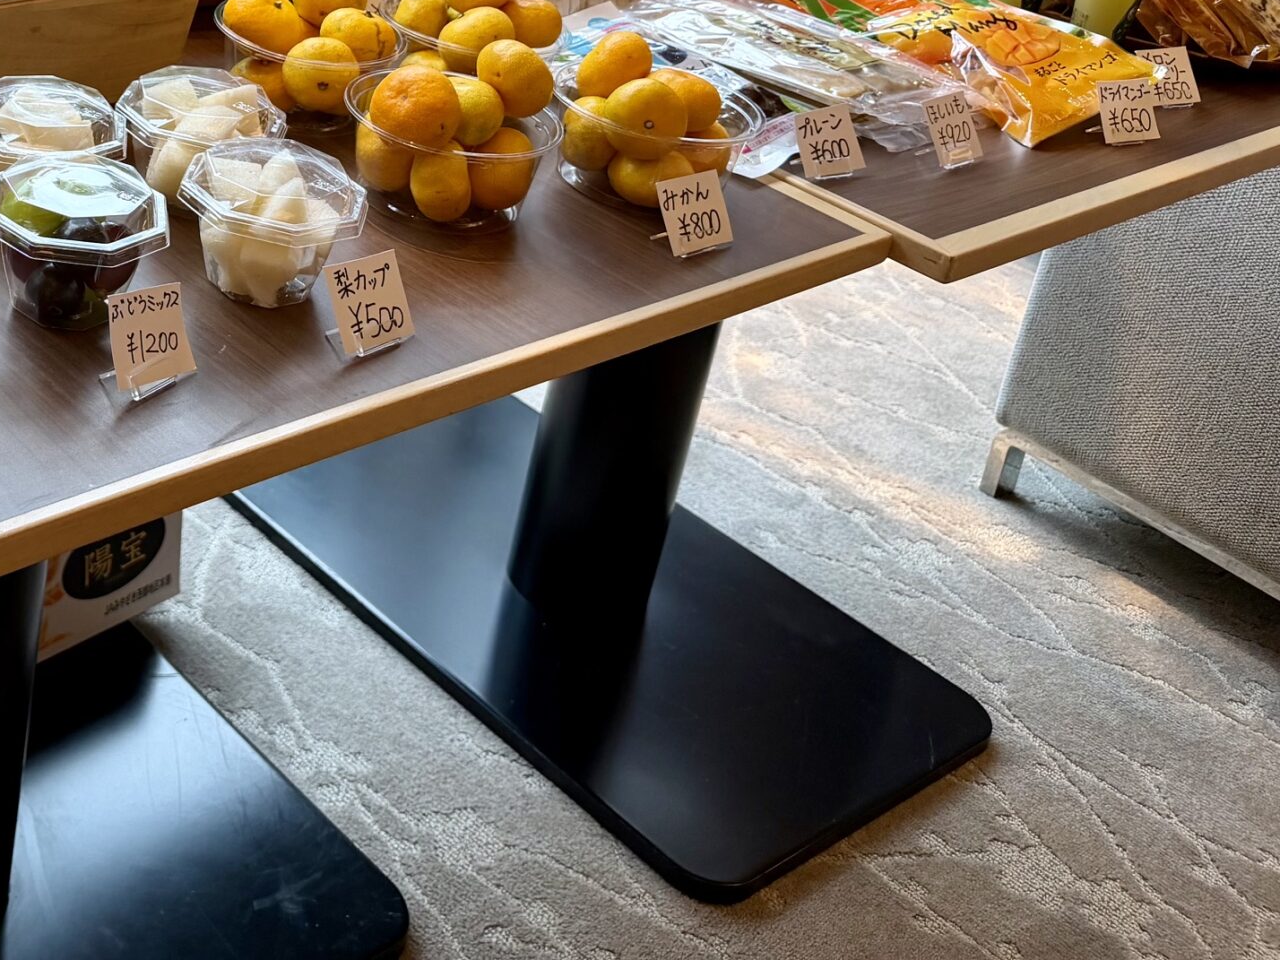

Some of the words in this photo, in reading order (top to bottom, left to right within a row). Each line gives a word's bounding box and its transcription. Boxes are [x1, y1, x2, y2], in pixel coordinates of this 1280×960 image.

[1099, 83, 1151, 104] ドライマンゴー
[798, 113, 843, 140] プルーン
[925, 95, 966, 126] ほしいも
[1108, 106, 1152, 134] ¥650
[808, 137, 851, 166] ¥600
[937, 119, 972, 152] ¥920
[662, 181, 710, 212] みかん
[677, 208, 722, 242] ¥800
[333, 262, 391, 300] 梨カップ
[110, 291, 181, 324] ぶどうミックス
[347, 300, 405, 340] ¥500
[126, 330, 179, 364] ¥1200
